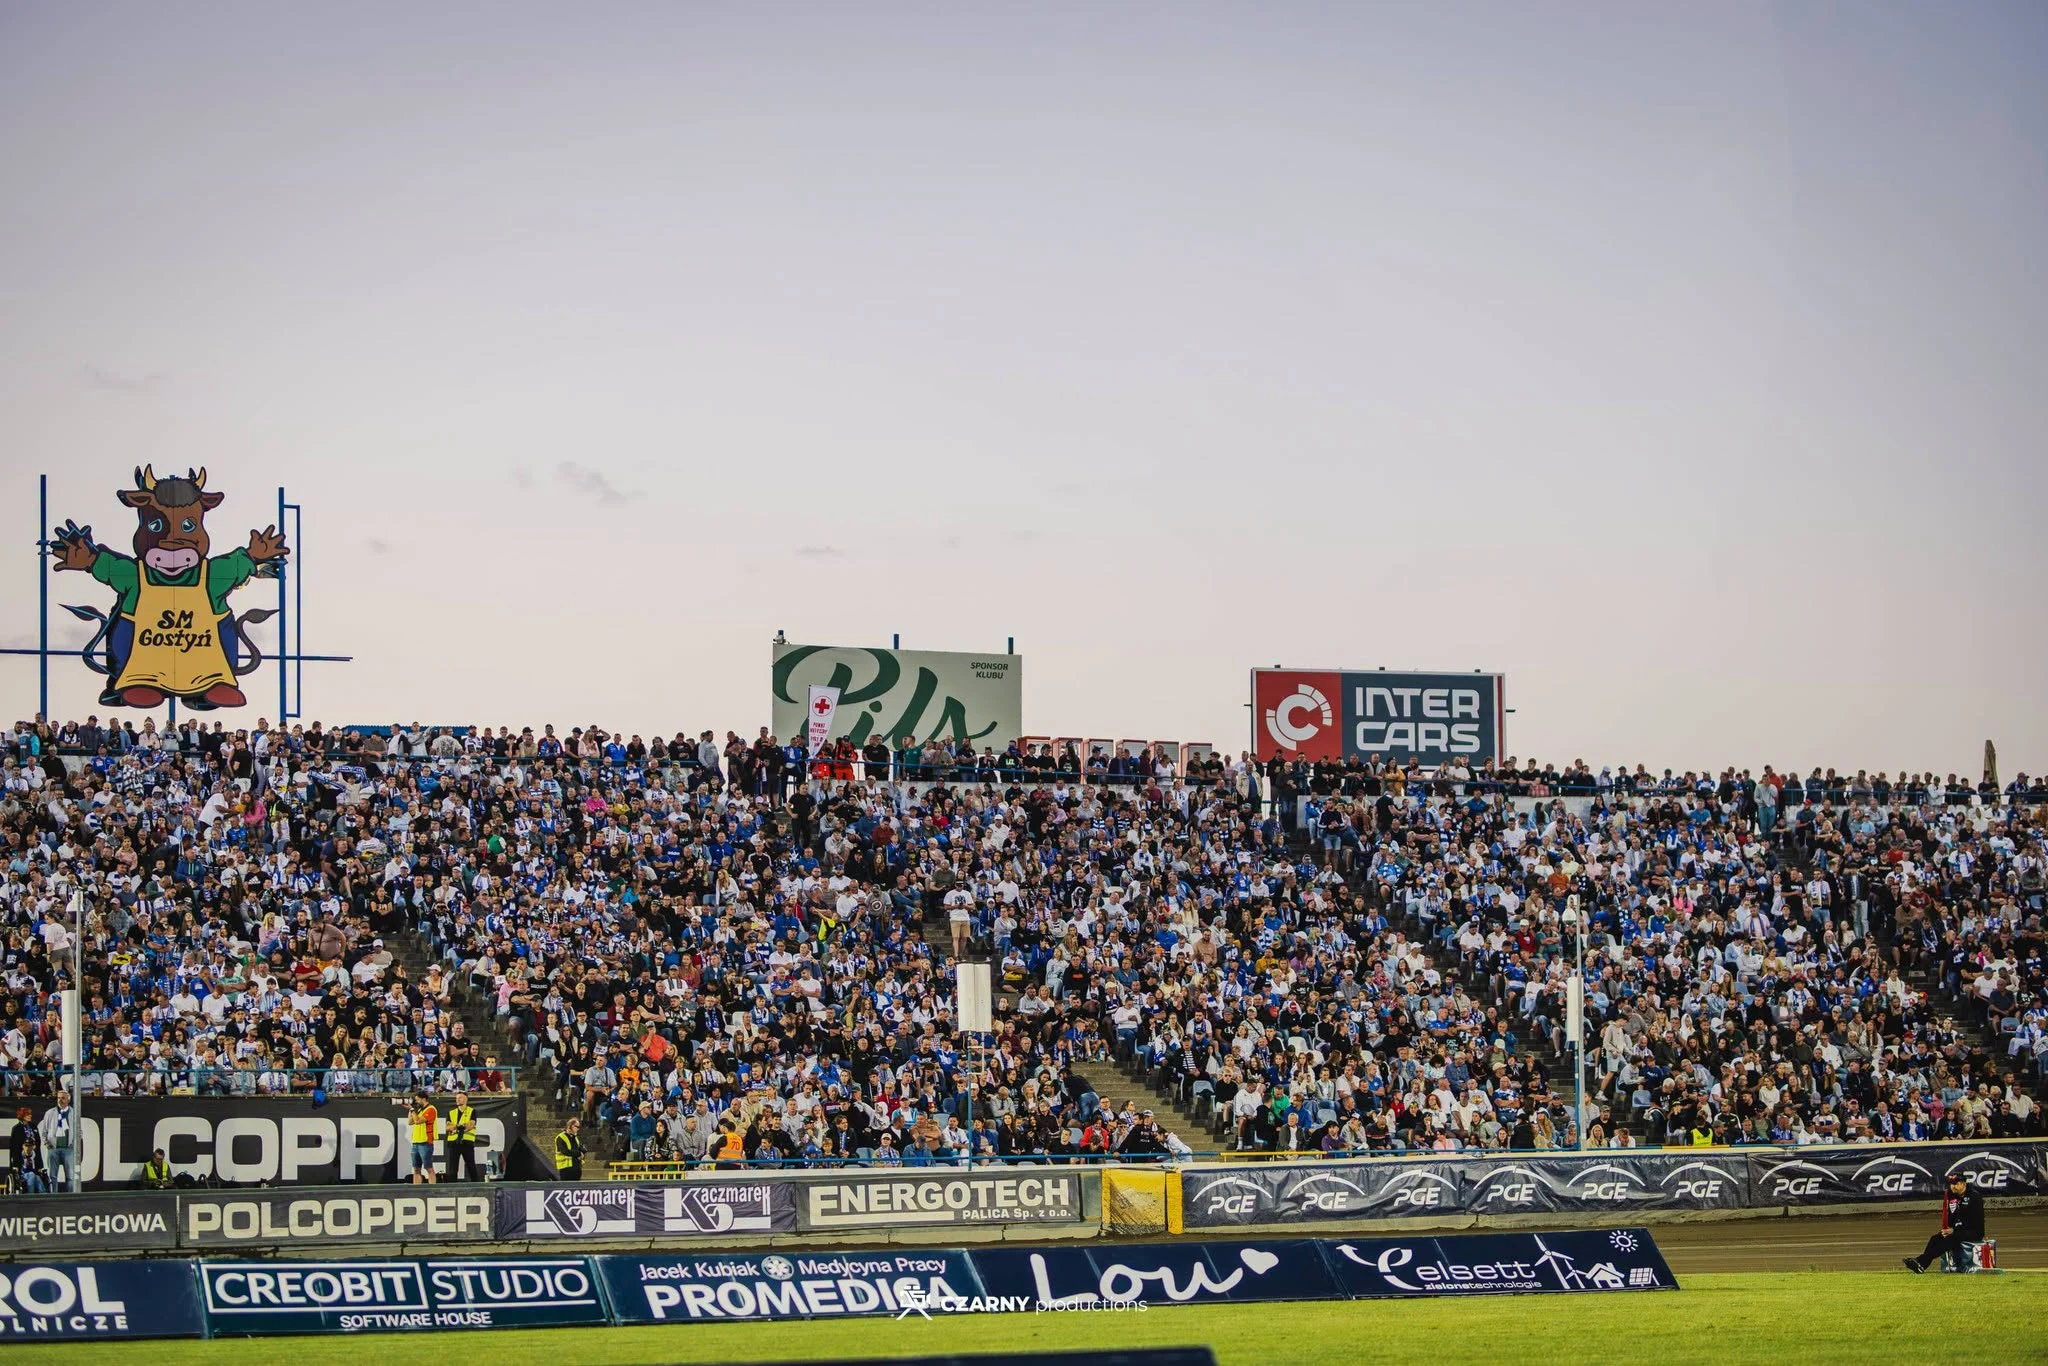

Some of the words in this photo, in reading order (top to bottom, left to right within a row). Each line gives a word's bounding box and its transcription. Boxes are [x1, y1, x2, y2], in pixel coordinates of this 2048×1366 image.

[157, 610, 194, 629] SM
[138, 629, 212, 653] Gostyń
[970, 662, 1009, 671] SPONSOR
[976, 671, 1004, 680] KLUBU
[1355, 687, 1481, 719] INTER
[1355, 721, 1481, 753] CARS
[731, 1141, 740, 1151] 70
[1773, 1177, 1822, 1196] PGE
[1866, 1173, 1915, 1192] PGE
[1962, 1169, 2010, 1188] PGE
[1393, 1187, 1441, 1207] PGE
[1487, 1184, 1536, 1202] PGE
[1581, 1180, 1629, 1200] PGE
[1674, 1180, 1722, 1199] PGE
[664, 1186, 771, 1233] Kaczmarek
[808, 1179, 1069, 1225] ENERGOTECH
[1208, 1195, 1256, 1215] PGE
[1301, 1191, 1349, 1210] PGE
[188, 1197, 490, 1240] POLCOPPER
[526, 1188, 636, 1235] Kaczmarek
[962, 1208, 1010, 1220] PALICA
[1013, 1208, 1034, 1219] Sp.
[1049, 1210, 1071, 1218] o.o.
[639, 1262, 692, 1280] Jacek
[694, 1261, 760, 1278] Kubiak
[797, 1258, 892, 1279] Medycyna
[895, 1256, 947, 1275] Pracy
[1416, 1260, 1537, 1281] elsett
[215, 1271, 411, 1305] CREOBIT
[431, 1268, 590, 1301] STUDIO
[0, 1315, 129, 1333] LNICZE
[340, 1313, 432, 1329] SOFTWARE
[435, 1311, 492, 1326] HOUSE
